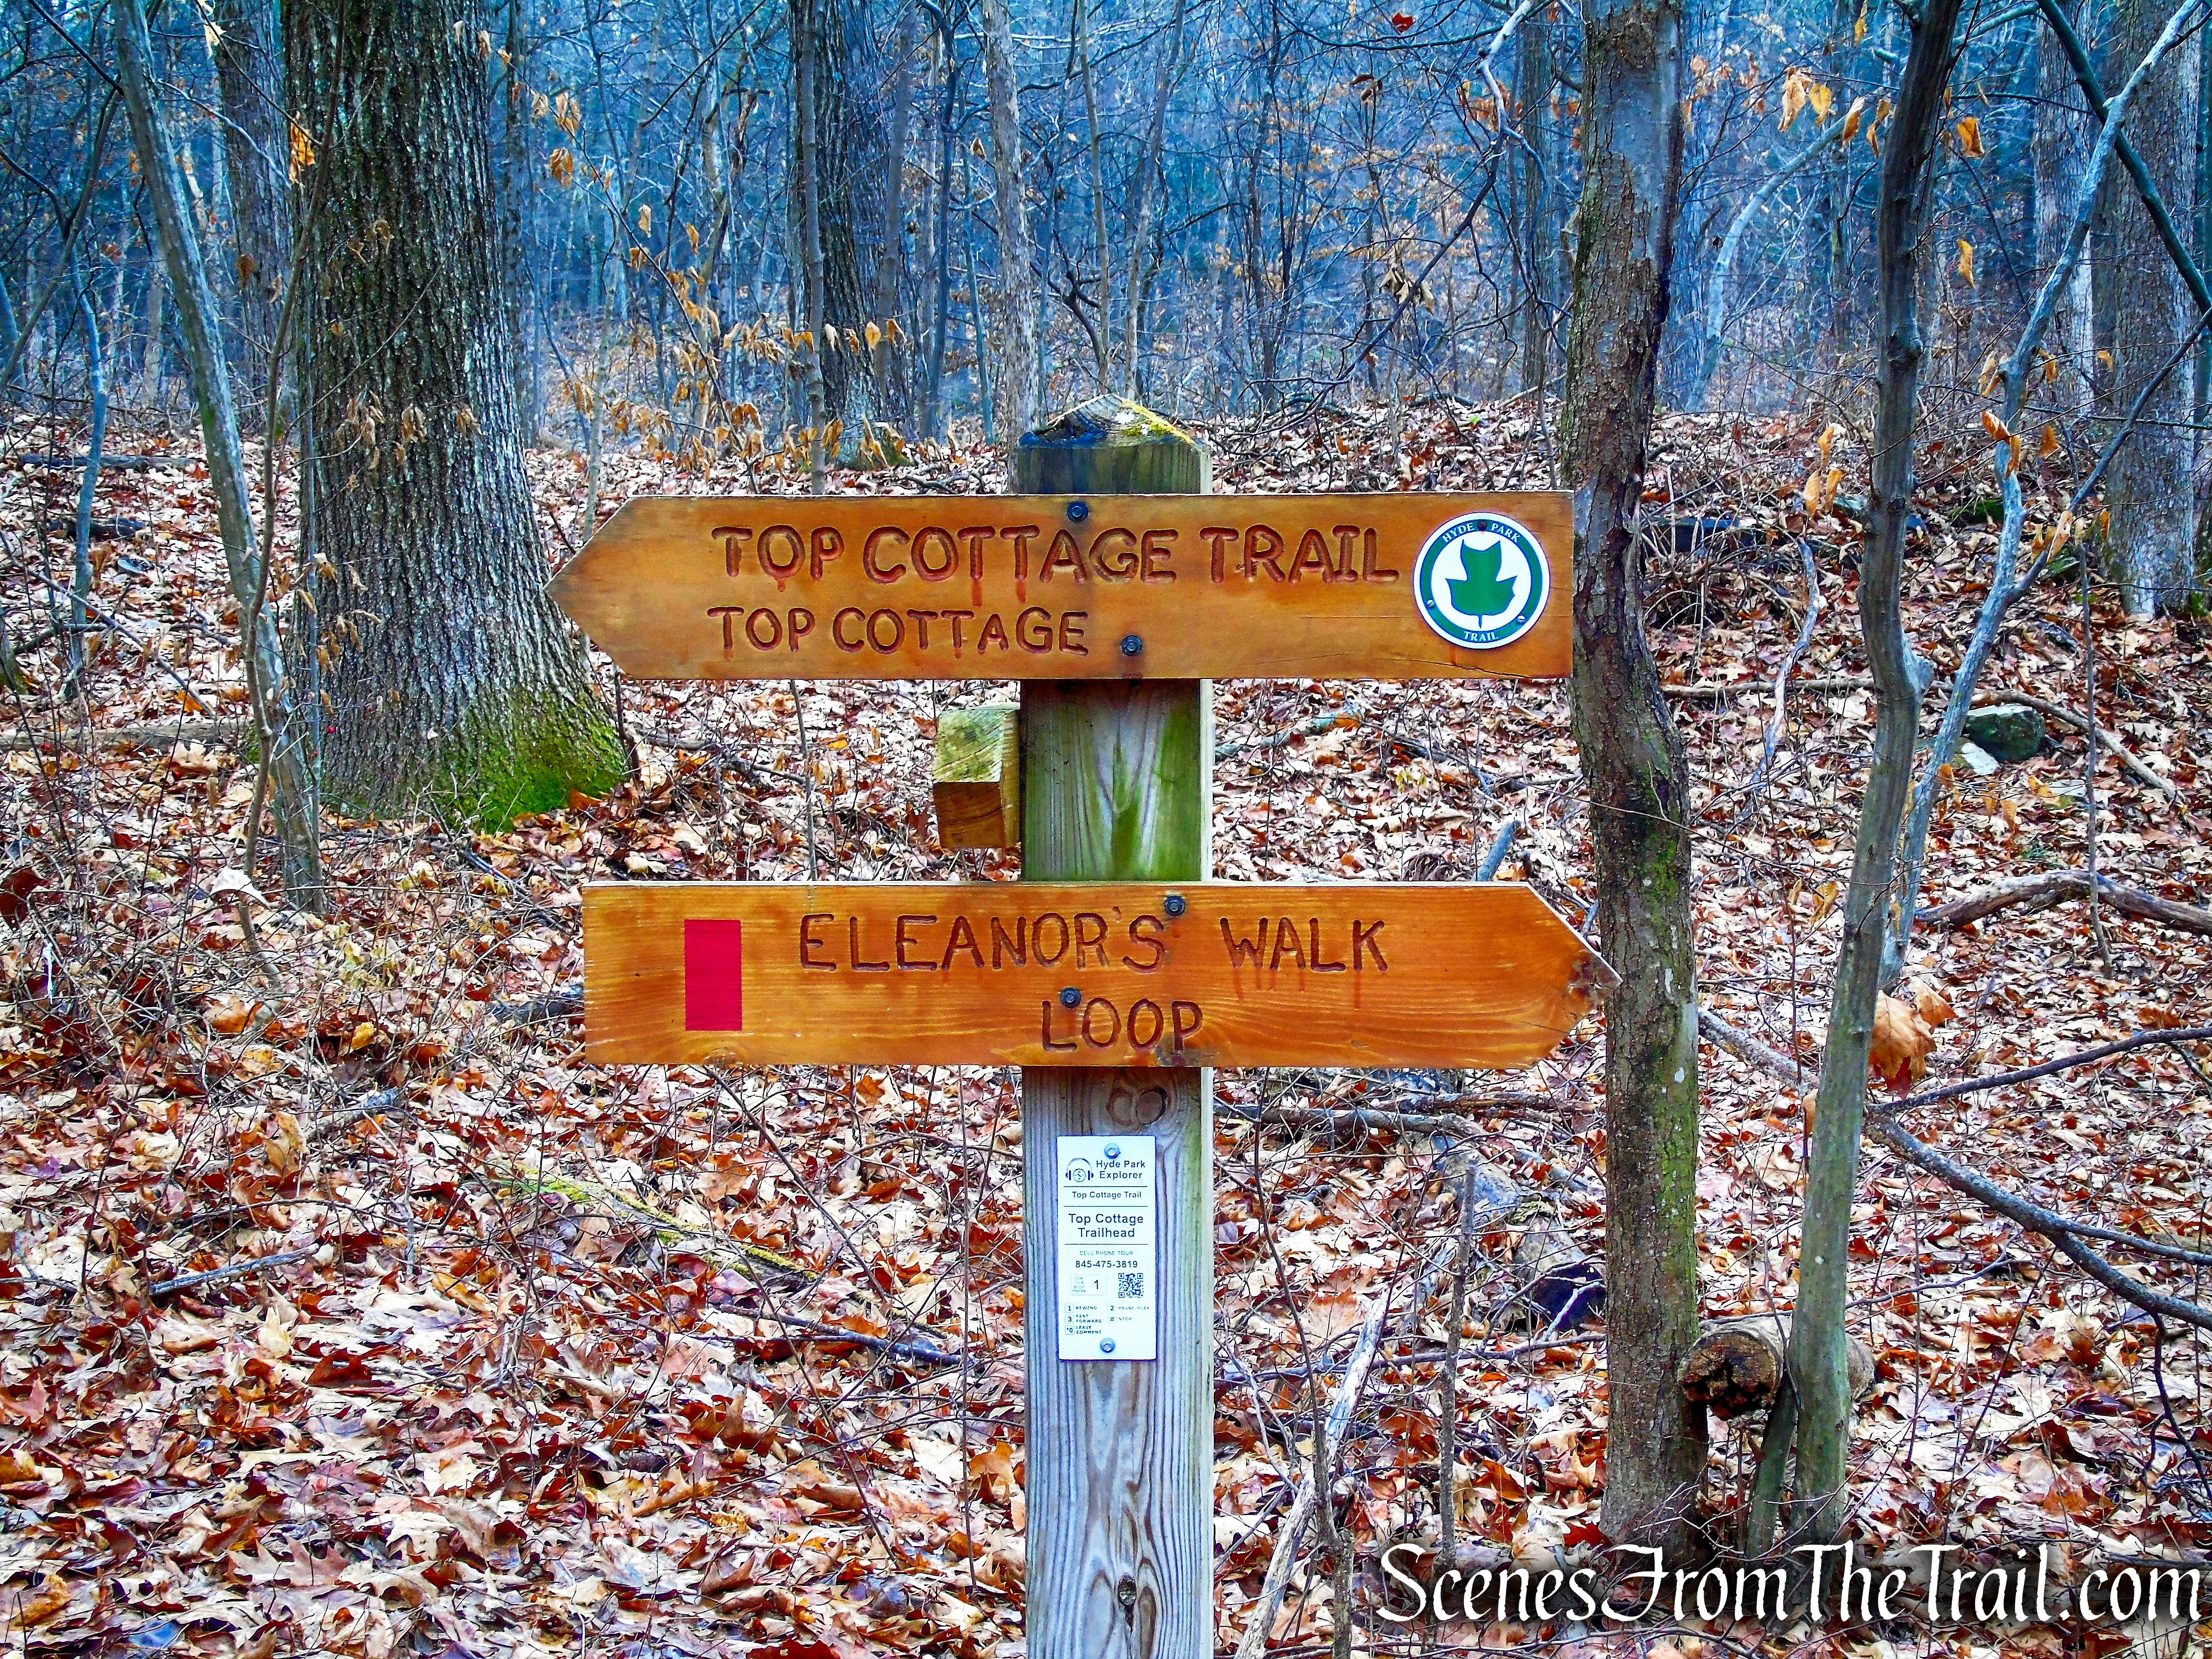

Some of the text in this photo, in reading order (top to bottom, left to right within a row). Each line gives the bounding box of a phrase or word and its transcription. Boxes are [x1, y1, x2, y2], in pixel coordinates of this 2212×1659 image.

[1442, 523, 1520, 543] HYDE PARK
[711, 524, 1400, 584] TOP COTTAGE TRAIL
[707, 606, 1089, 656] TOP COTTAGE
[1464, 631, 1499, 641] TRAIL
[800, 906, 1388, 974] ELEANOR'S WALK
[1042, 997, 1203, 1053] LOOP
[1096, 1160, 1121, 1169] Hyde
[1100, 1171, 1142, 1180] Explorer
[1069, 1214, 1143, 1226] Top Cottage
[1078, 1228, 1134, 1237] Trailhead
[1094, 1279, 1098, 1289] 1
